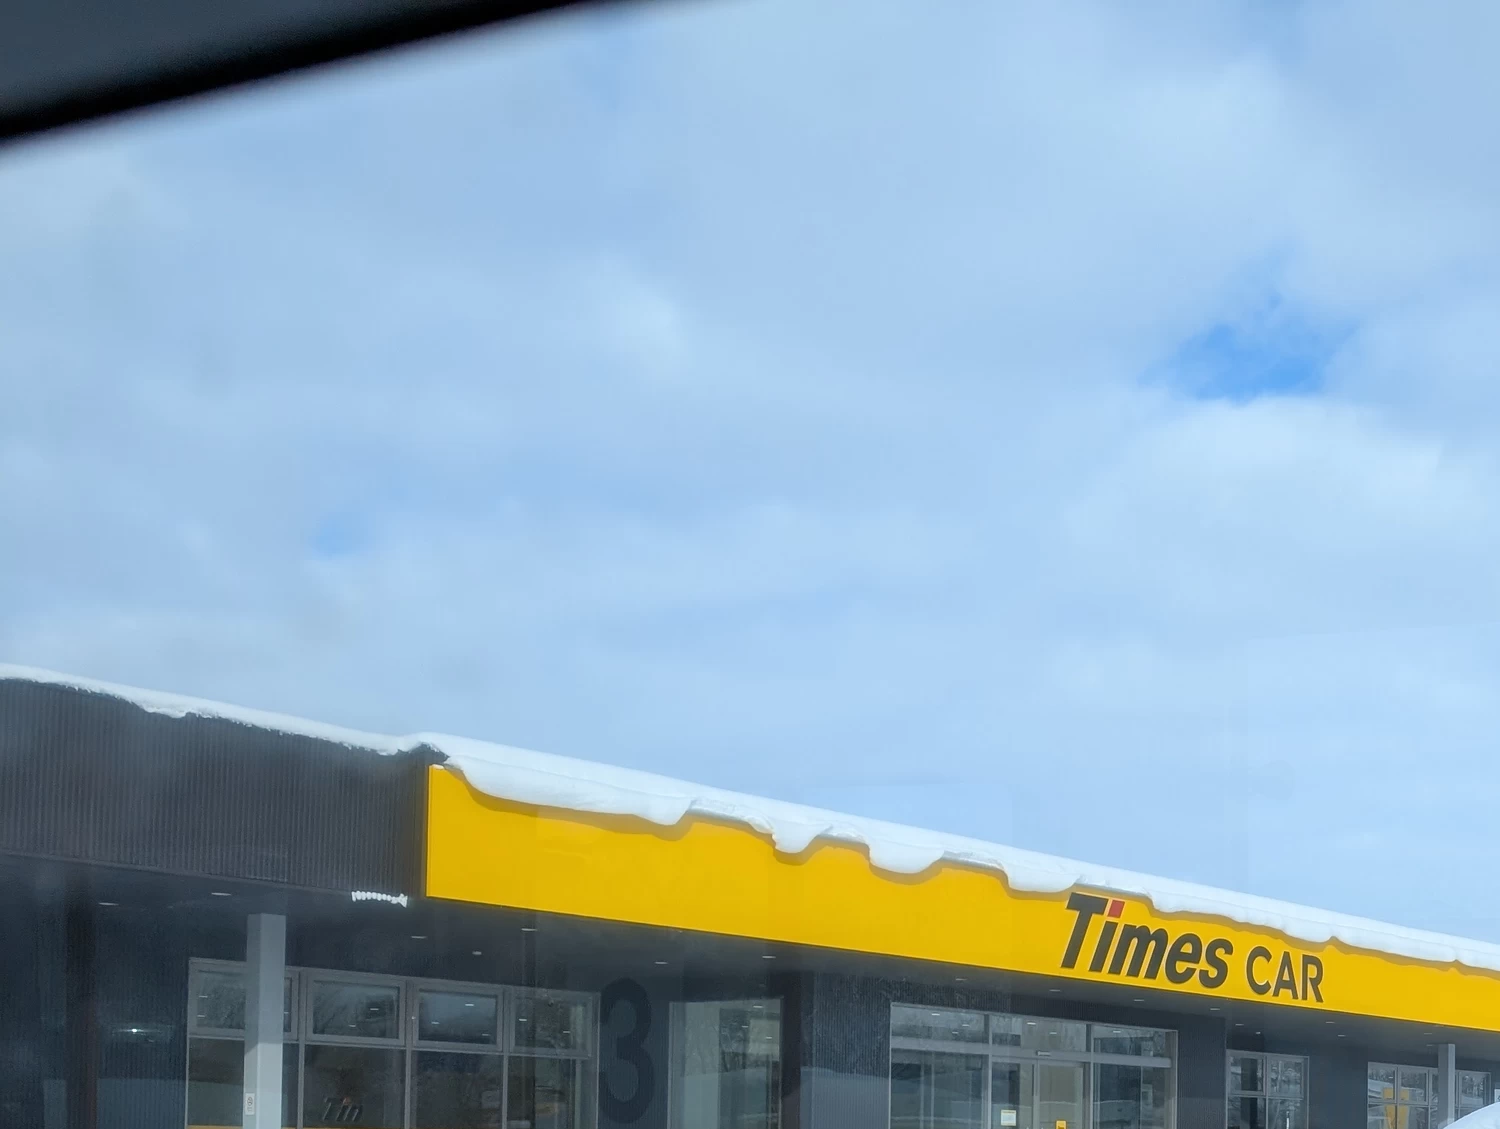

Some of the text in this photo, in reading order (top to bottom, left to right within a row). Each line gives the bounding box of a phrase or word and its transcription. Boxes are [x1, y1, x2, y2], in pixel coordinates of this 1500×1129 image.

[1060, 892, 1324, 1003] Times CAR
[598, 977, 655, 1125] 3
